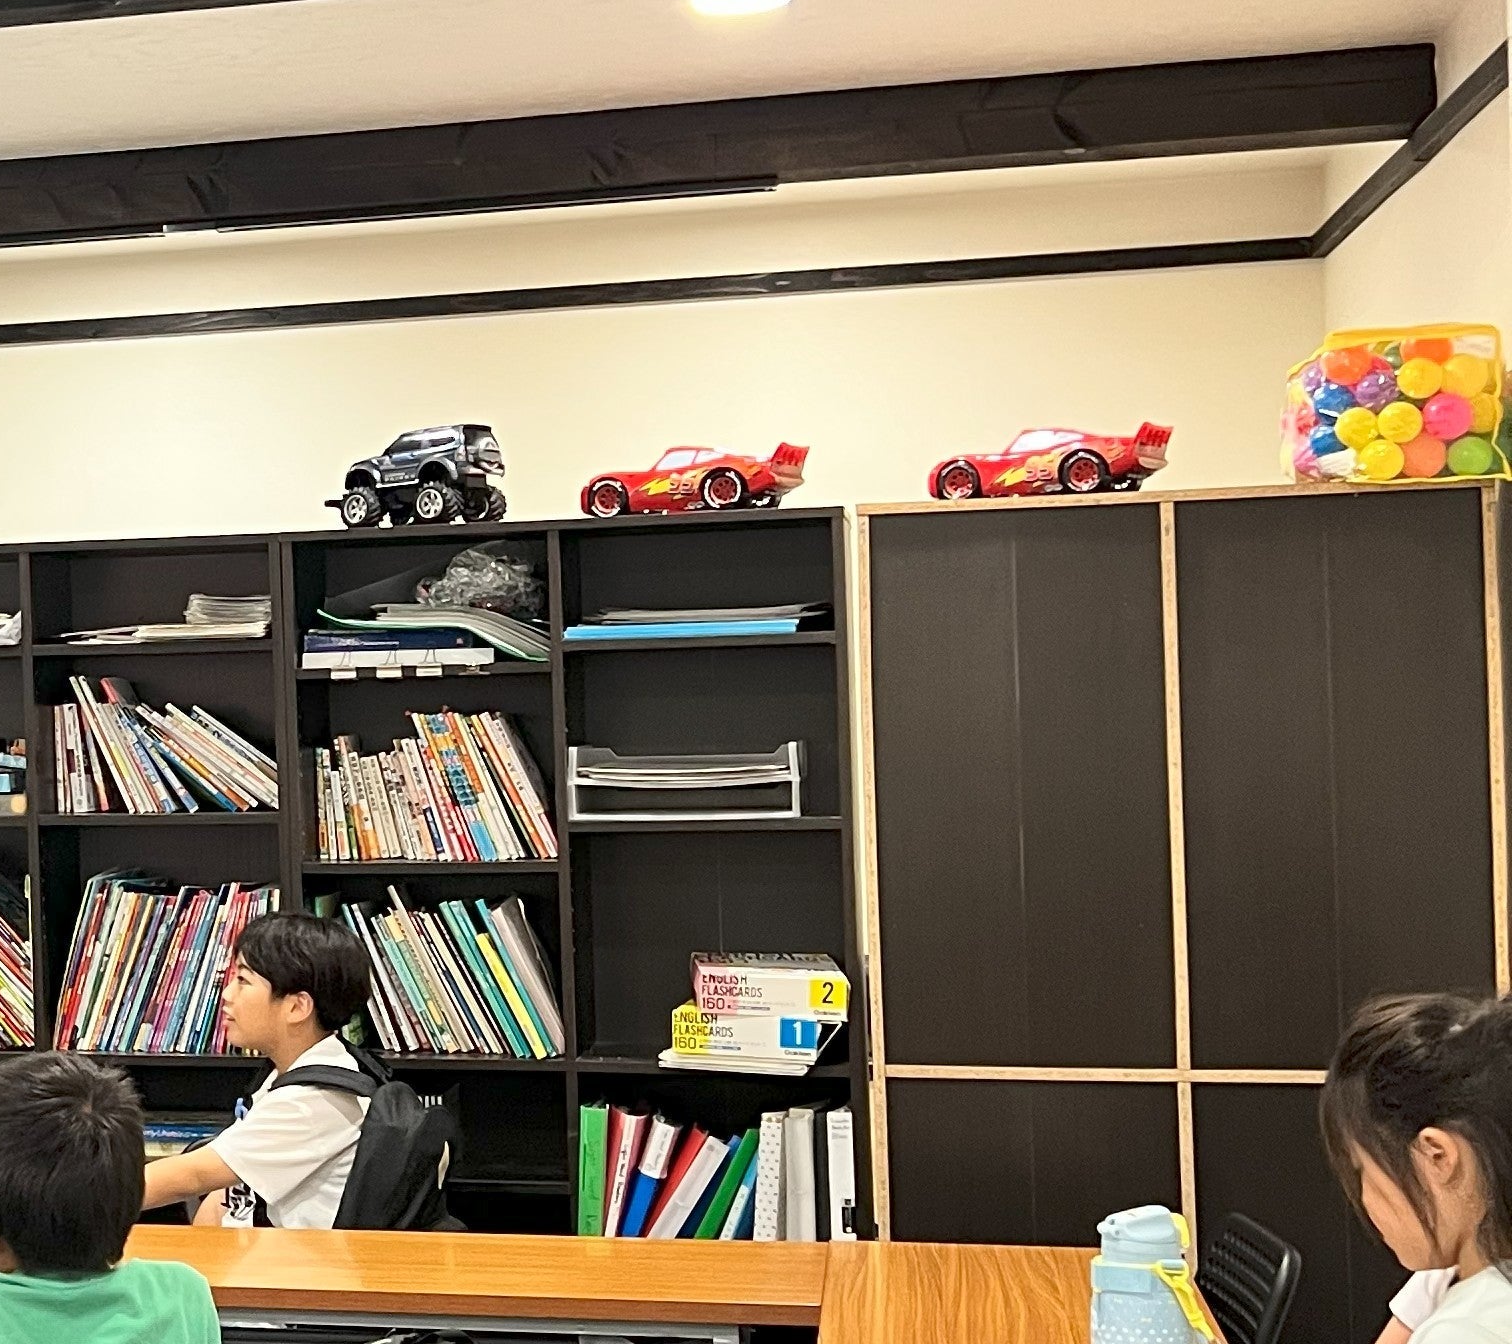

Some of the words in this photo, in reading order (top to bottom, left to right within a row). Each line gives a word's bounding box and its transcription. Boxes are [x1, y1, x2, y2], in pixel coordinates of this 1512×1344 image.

[702, 973, 748, 985] ENGLISH
[701, 984, 763, 998] FLASHCARDS
[821, 981, 834, 1004] 2
[702, 997, 725, 1010] 160
[674, 1012, 718, 1024] ENGLISH
[673, 1024, 734, 1038] FLASHCARDS
[792, 1021, 802, 1046] 1
[674, 1036, 697, 1050] 160
